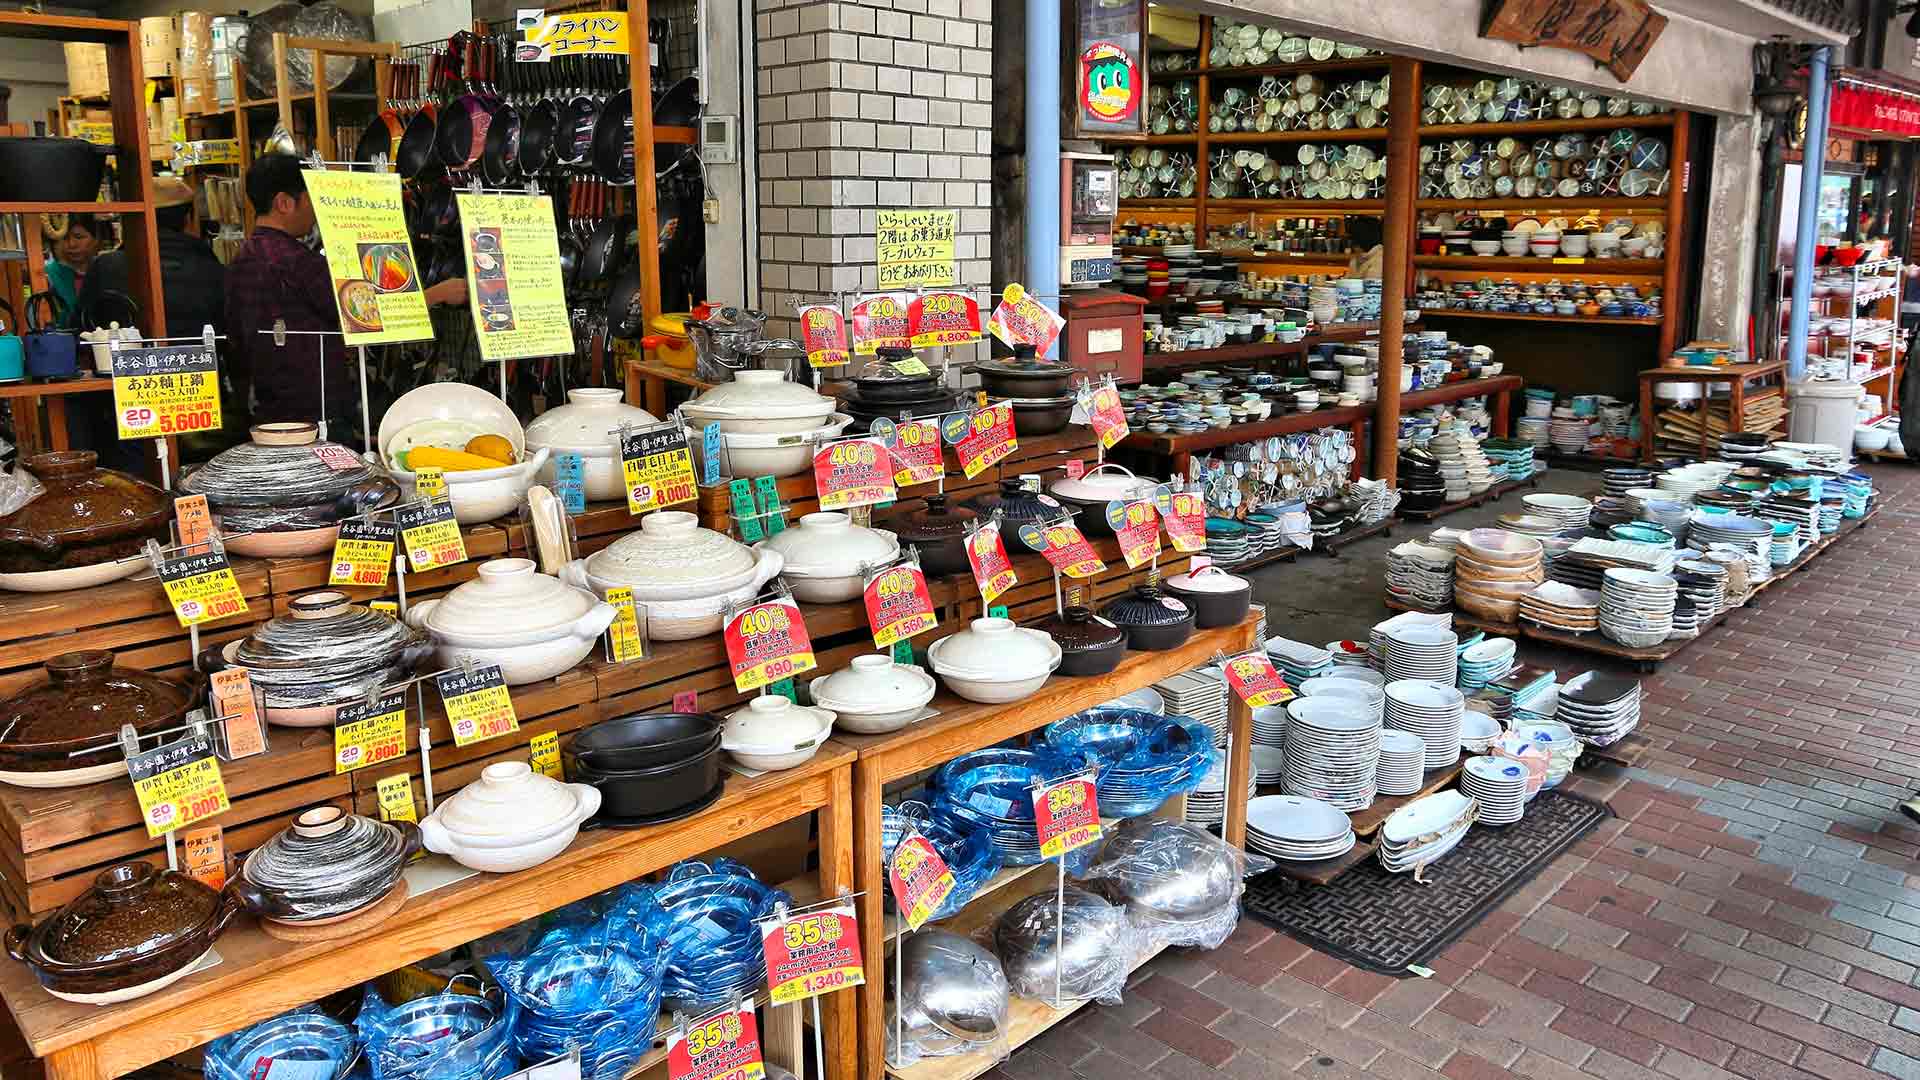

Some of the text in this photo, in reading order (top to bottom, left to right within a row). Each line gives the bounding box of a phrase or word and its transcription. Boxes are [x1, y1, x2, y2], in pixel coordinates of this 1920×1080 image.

[552, 16, 620, 35] フライパン
[555, 37, 617, 51] コーナー
[1090, 263, 1111, 275] 21-6
[868, 298, 895, 318] 20
[922, 295, 951, 314] 20
[126, 408, 152, 421] 20
[159, 410, 212, 433] 5,600
[973, 410, 995, 434] 10
[898, 424, 921, 447] 10
[317, 447, 337, 458] 20
[831, 444, 860, 466] 40
[633, 485, 651, 498] 20
[655, 483, 691, 505] 8,000
[413, 550, 427, 559] 20
[336, 563, 351, 572] 20
[878, 572, 903, 598] 40
[181, 601, 198, 613] 20
[741, 608, 772, 636] 40
[766, 659, 792, 679] 990
[457, 720, 473, 731] 20
[342, 747, 359, 759] 20
[365, 743, 399, 764] 2,800
[180, 795, 220, 822] 2,800
[1047, 784, 1073, 813] 35
[151, 804, 171, 818] 20
[1063, 829, 1089, 847] 1,800
[894, 846, 918, 880] 35
[784, 917, 822, 950] 35
[804, 971, 844, 992] 1,340
[687, 1019, 723, 1056] 35
